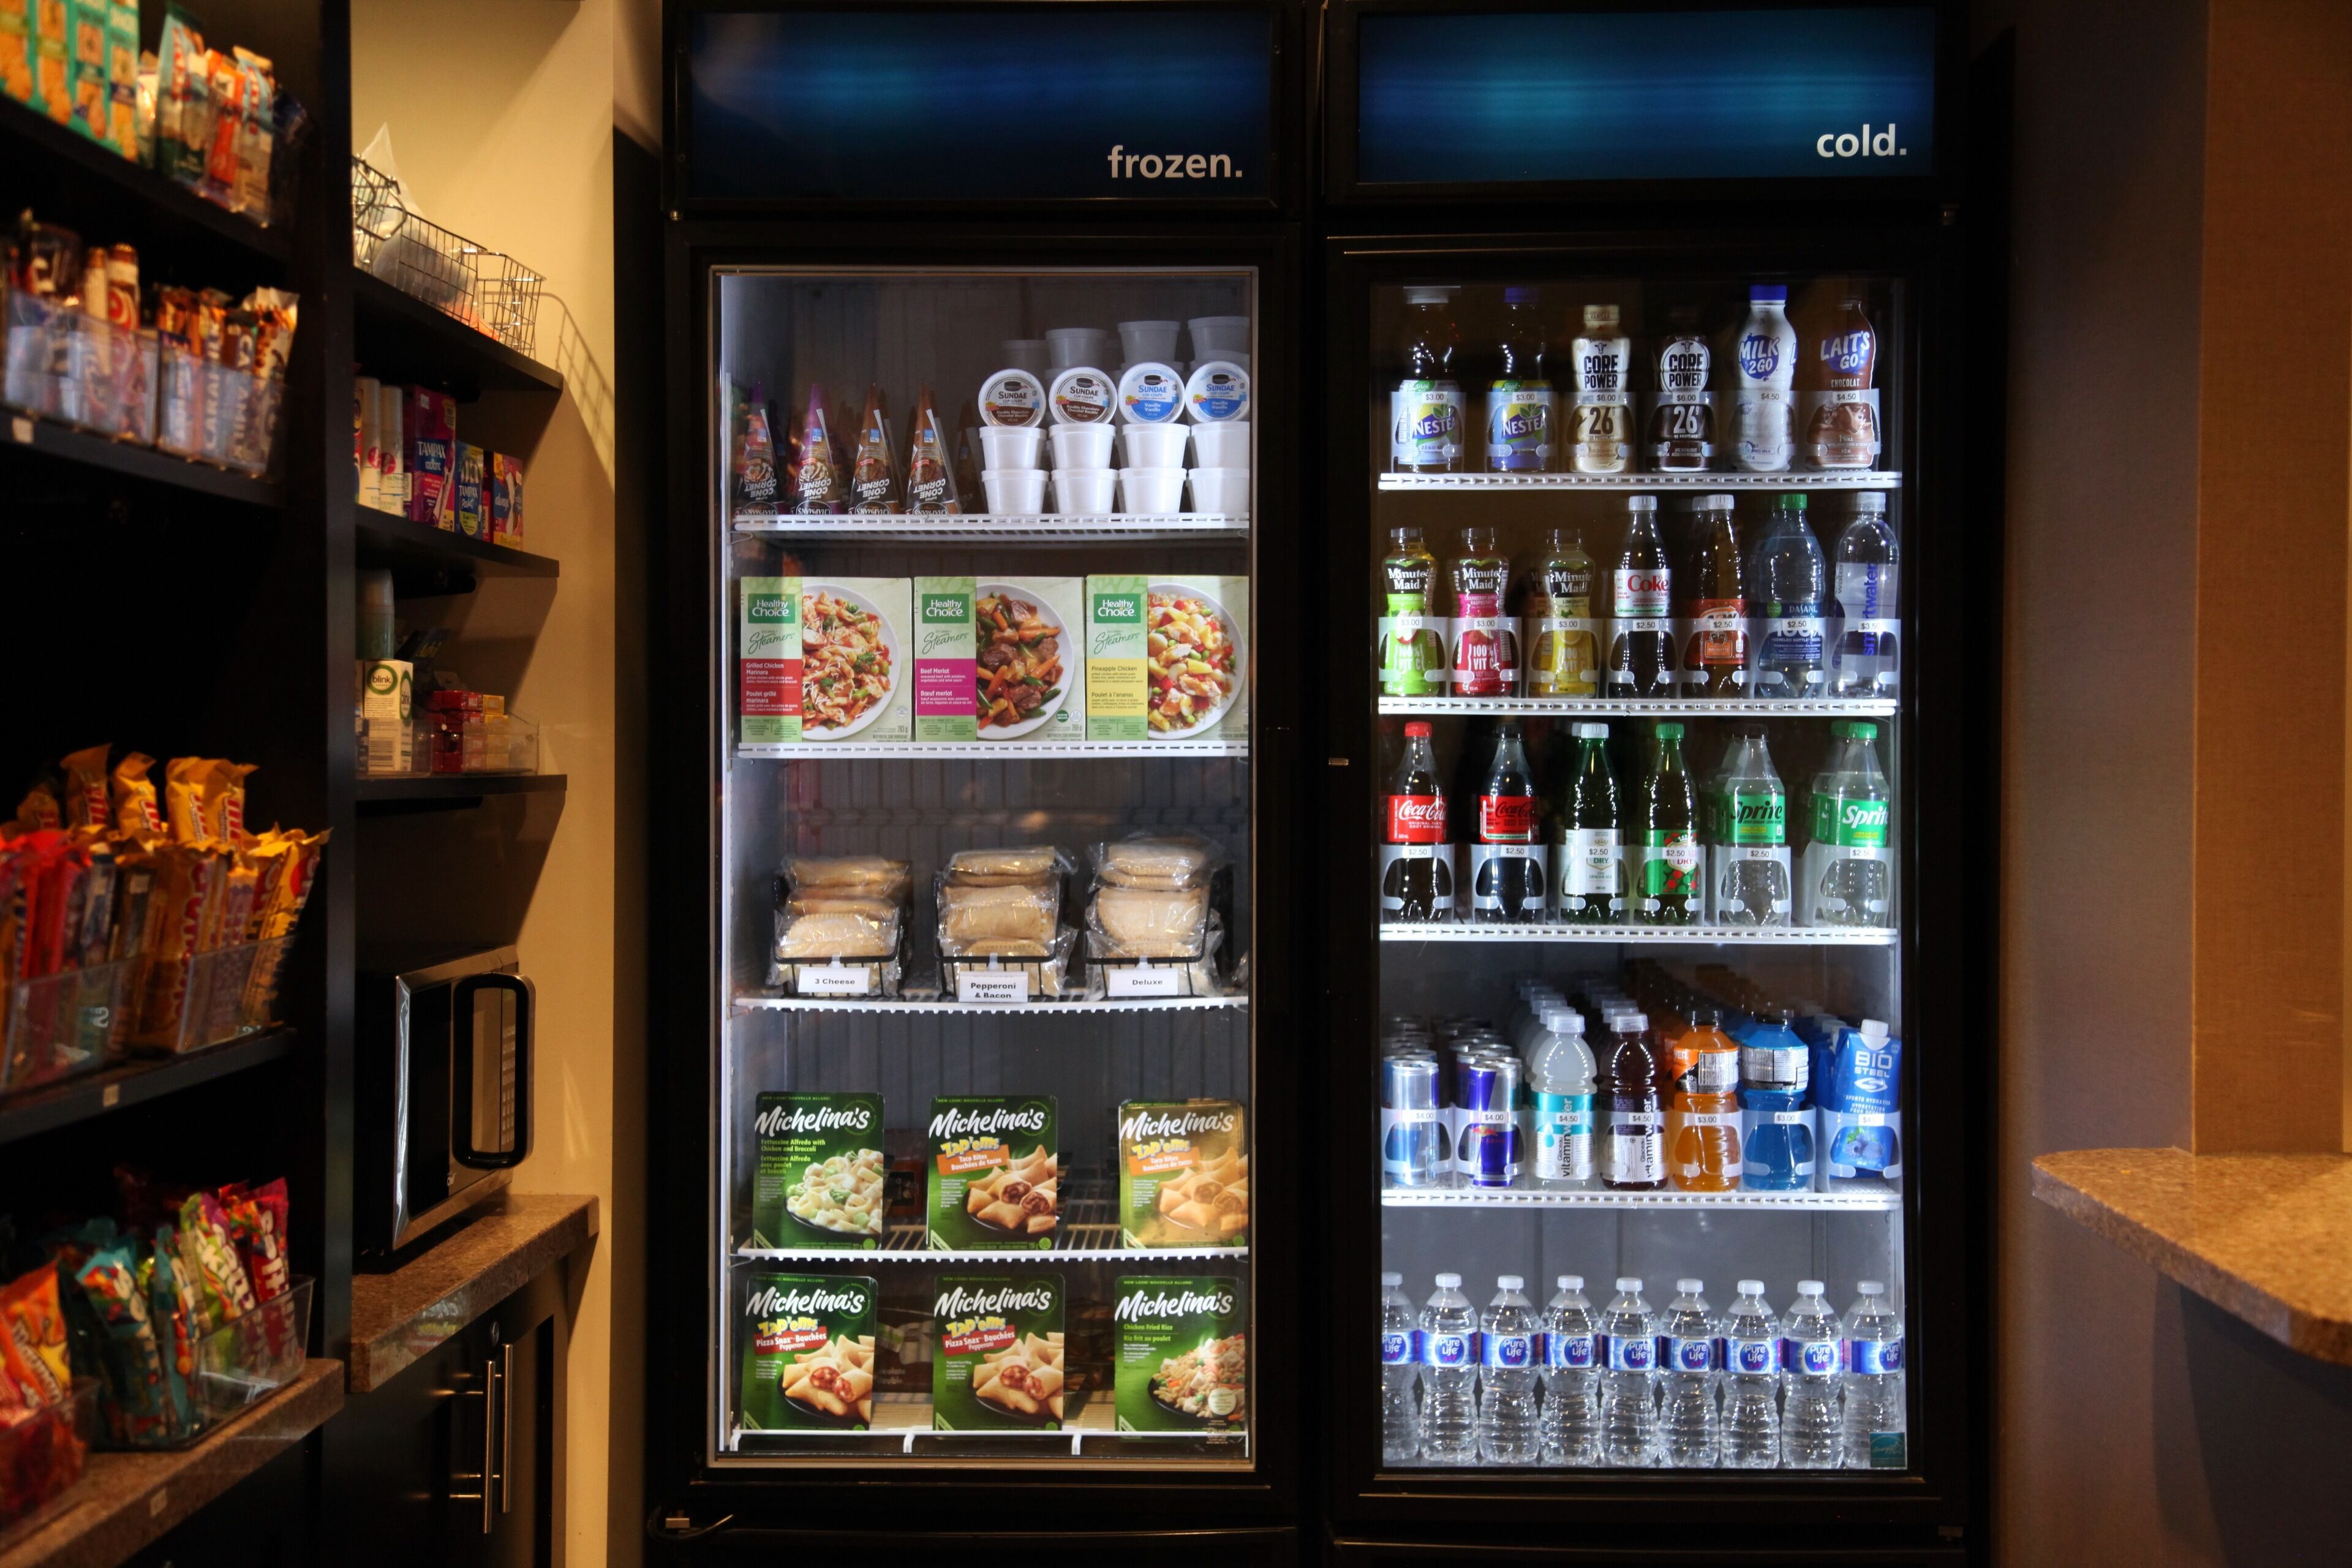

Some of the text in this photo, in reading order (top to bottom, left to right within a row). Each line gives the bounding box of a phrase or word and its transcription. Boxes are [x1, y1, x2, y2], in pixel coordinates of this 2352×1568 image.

[1817, 123, 1907, 157] cold.
[1107, 145, 1242, 178] frozen.
[1738, 337, 1781, 363] MILK
[1820, 330, 1870, 361] LAIT'S
[1583, 353, 1619, 374] CORE
[1668, 353, 1704, 373] CORE
[1748, 356, 1774, 375] 2GO
[1840, 354, 1859, 369] GO
[1584, 374, 1619, 389] POWER
[1668, 372, 1703, 388] POWER
[1830, 378, 1861, 388] CHOCOLAT
[1069, 386, 1099, 397] SUNDAE
[1138, 385, 1168, 393] SUNDAE
[1205, 383, 1235, 392] SUNDAE
[998, 391, 1028, 399] SUNDAE
[1502, 413, 1548, 437] NESTEA
[417, 440, 447, 459] TAMPAX
[744, 478, 777, 492] CORNET
[798, 478, 832, 491] CORNET
[857, 478, 890, 492] CORNET
[913, 478, 946, 494] CORNET
[458, 484, 478, 499] TAMPAX
[749, 488, 774, 499] CONE
[803, 487, 828, 498] CONE
[862, 487, 887, 498] CONE
[919, 487, 943, 499] CONE
[1388, 568, 1426, 579] Minute
[1462, 568, 1500, 579] Minute
[1554, 571, 1593, 583] Minute
[1394, 579, 1421, 590] Maid
[1468, 579, 1493, 590] Maid
[1561, 582, 1588, 594] Maid
[1627, 575, 1668, 593] Coke
[757, 599, 788, 610] Healthy
[930, 599, 962, 610] Healthy
[1102, 599, 1134, 610] Healthy
[1789, 605, 1818, 615] DASANI
[752, 607, 790, 617] Choice
[925, 607, 963, 617] Choice
[1097, 607, 1135, 617] Choice
[1860, 622, 1881, 630] $3.50
[748, 631, 794, 655] Steamers
[921, 631, 968, 655] Steamers
[1093, 631, 1139, 655] Steamers
[372, 675, 392, 684] blink
[1398, 799, 1446, 821] Coca-Cola
[1730, 800, 1783, 824] Sprite
[970, 982, 1016, 991] Pepperoni
[1854, 1051, 1893, 1070] BIO
[1854, 1067, 1890, 1079] STEEL
[754, 1105, 871, 1137] Michelina's
[929, 1107, 1045, 1140] Michelina's
[1119, 1111, 1235, 1142] Michelina's
[940, 1136, 1001, 1158] Zap'ems
[1131, 1138, 1191, 1161] Zap'ems
[951, 1161, 978, 1171] Bouchées
[745, 1286, 865, 1318] Michelina's
[934, 1286, 1052, 1319] Michelina's
[1114, 1289, 1234, 1323] Michelina's
[757, 1316, 820, 1338] Zap'ems
[945, 1316, 1007, 1340] Zap'ems
[756, 1332, 827, 1348] Pizza Snax Bouchées
[945, 1331, 1016, 1349] Pizza Snax Bouchées
[1439, 1337, 1461, 1348] Pure
[1504, 1338, 1525, 1349] Pure
[1569, 1338, 1591, 1349] Pure
[1629, 1341, 1649, 1351] Pure
[778, 1342, 806, 1352] Pepperoni
[1442, 1344, 1460, 1355] Life
[1506, 1346, 1523, 1357] Life
[1572, 1346, 1589, 1357] Life
[1686, 1343, 1707, 1352] Pure
[1744, 1343, 1766, 1354] Pure
[1810, 1344, 1831, 1355] Pure
[1631, 1349, 1648, 1360] Life
[1689, 1351, 1706, 1361] Life
[1747, 1352, 1764, 1362] Life
[1812, 1352, 1829, 1363] Life
